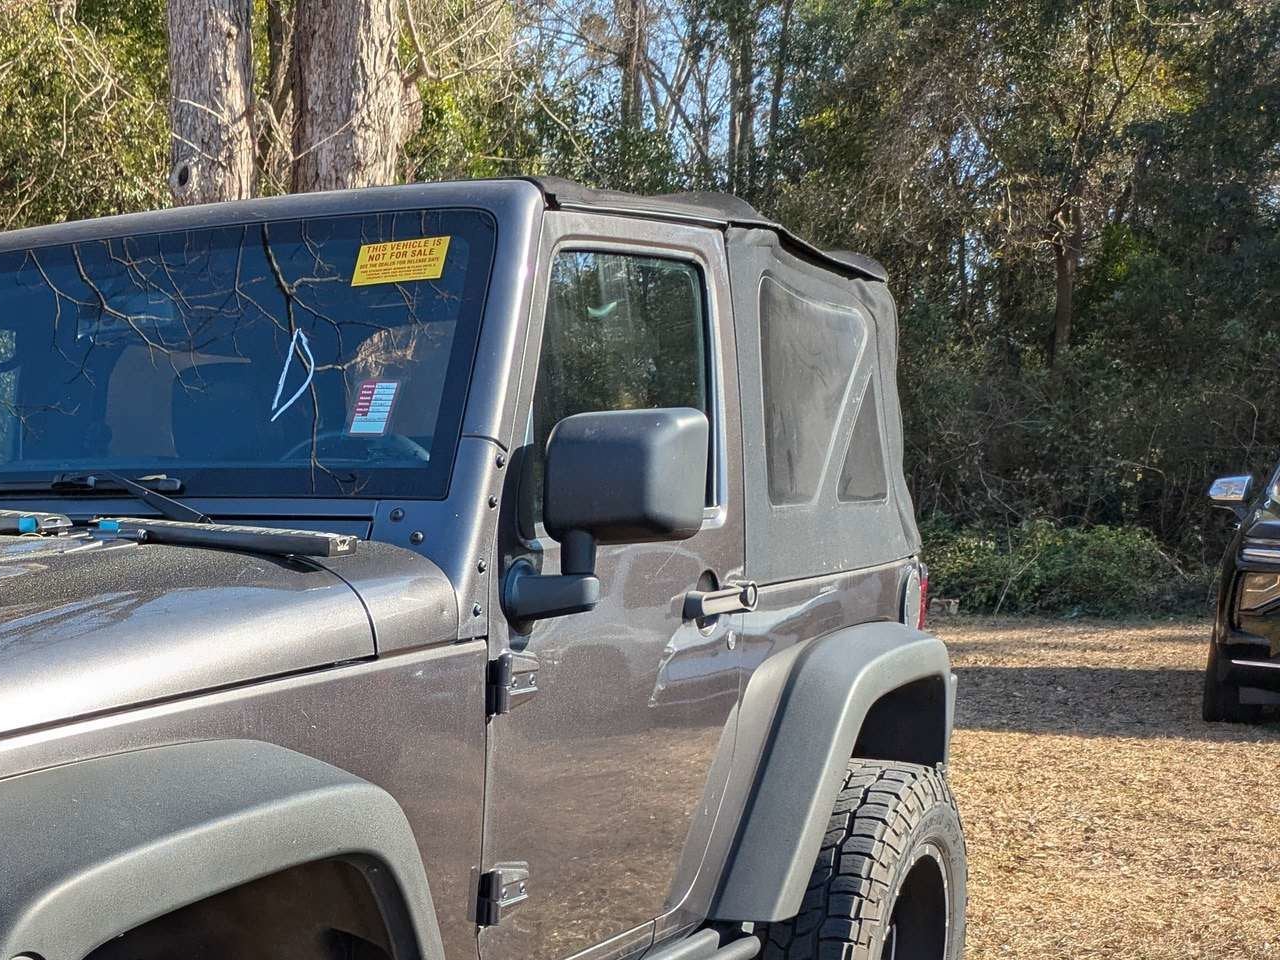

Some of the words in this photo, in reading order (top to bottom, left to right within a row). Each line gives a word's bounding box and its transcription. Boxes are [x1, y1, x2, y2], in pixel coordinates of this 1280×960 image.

[367, 244, 387, 254] THIS
[390, 240, 429, 251] VEHICLE
[432, 238, 442, 246] IS
[367, 253, 387, 262] NOT
[390, 251, 407, 260] FOR
[410, 248, 435, 258] SALE
